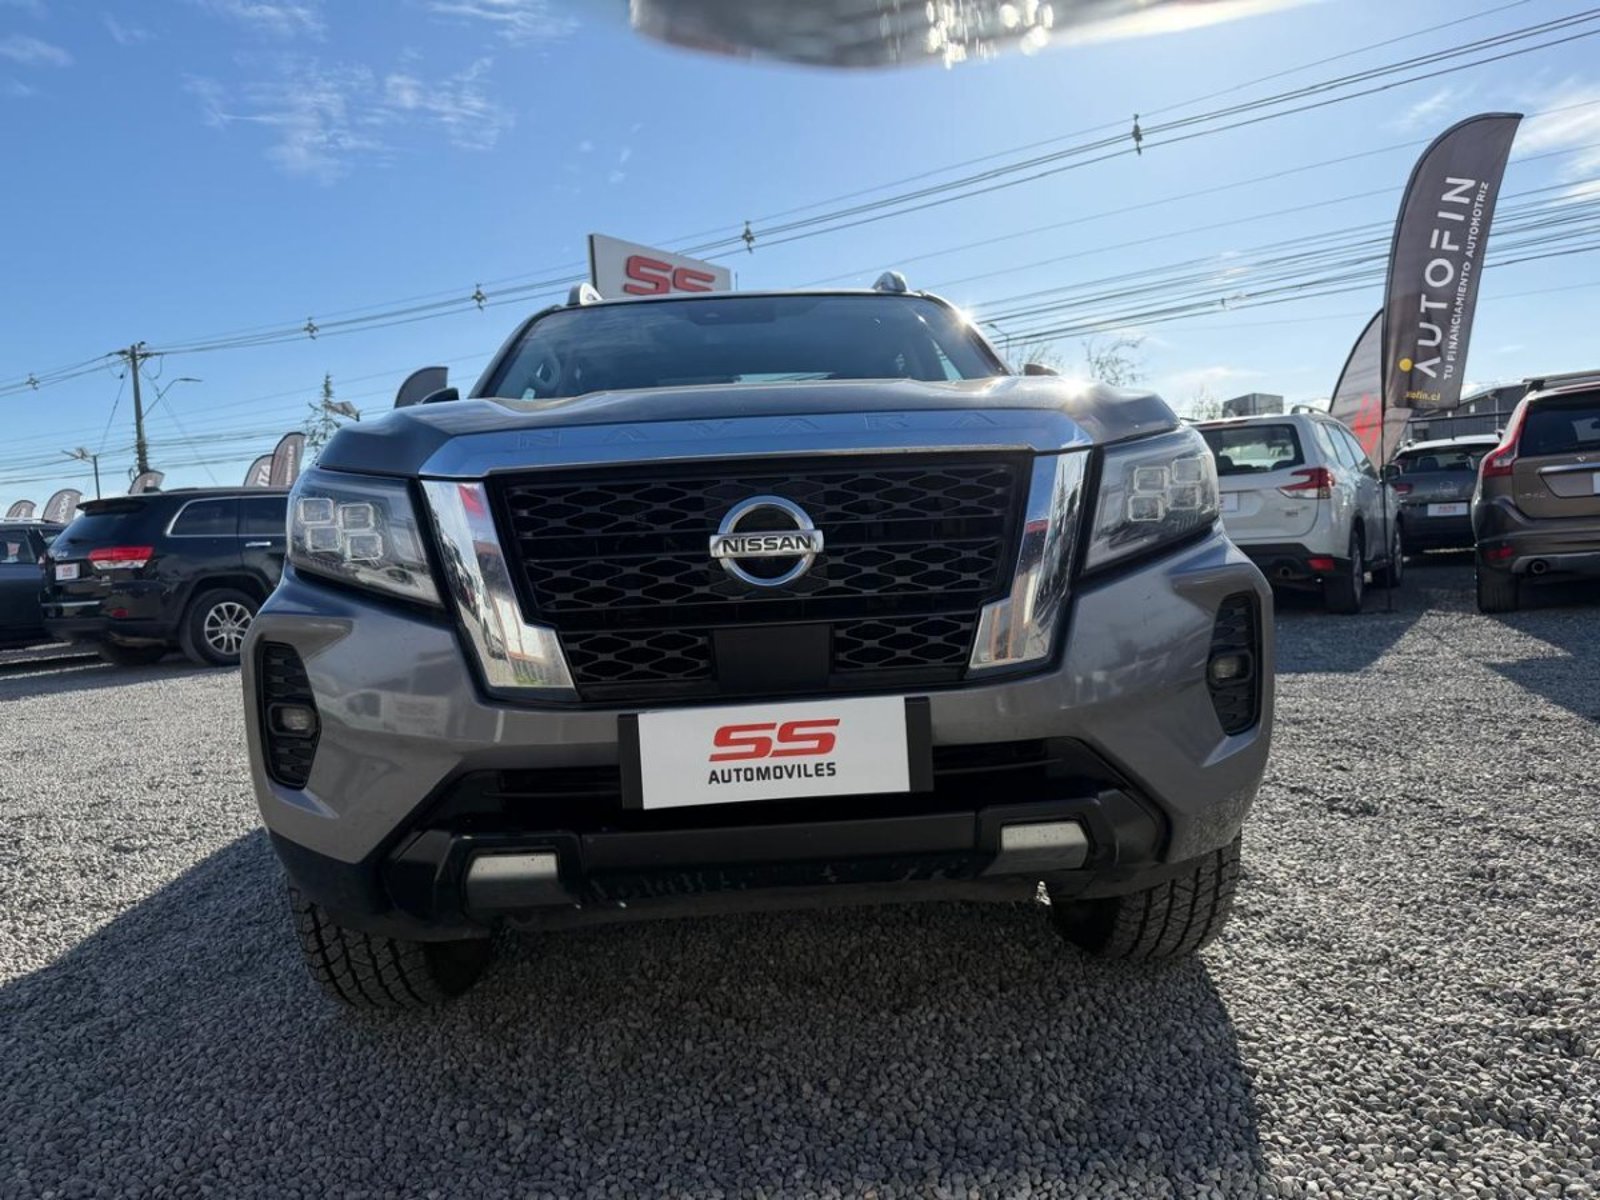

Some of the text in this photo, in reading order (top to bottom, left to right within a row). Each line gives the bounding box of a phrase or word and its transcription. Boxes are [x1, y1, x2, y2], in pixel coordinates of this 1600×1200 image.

[1414, 177, 1476, 378] AUTOFIN
[1443, 181, 1490, 380] TU FINANCIAMIENTO AUTOMOTRIZ
[517, 411, 999, 450] NAVARA
[721, 535, 813, 553] NISSAN
[708, 718, 841, 762] SS
[708, 762, 836, 785] AUTOMOVILES
